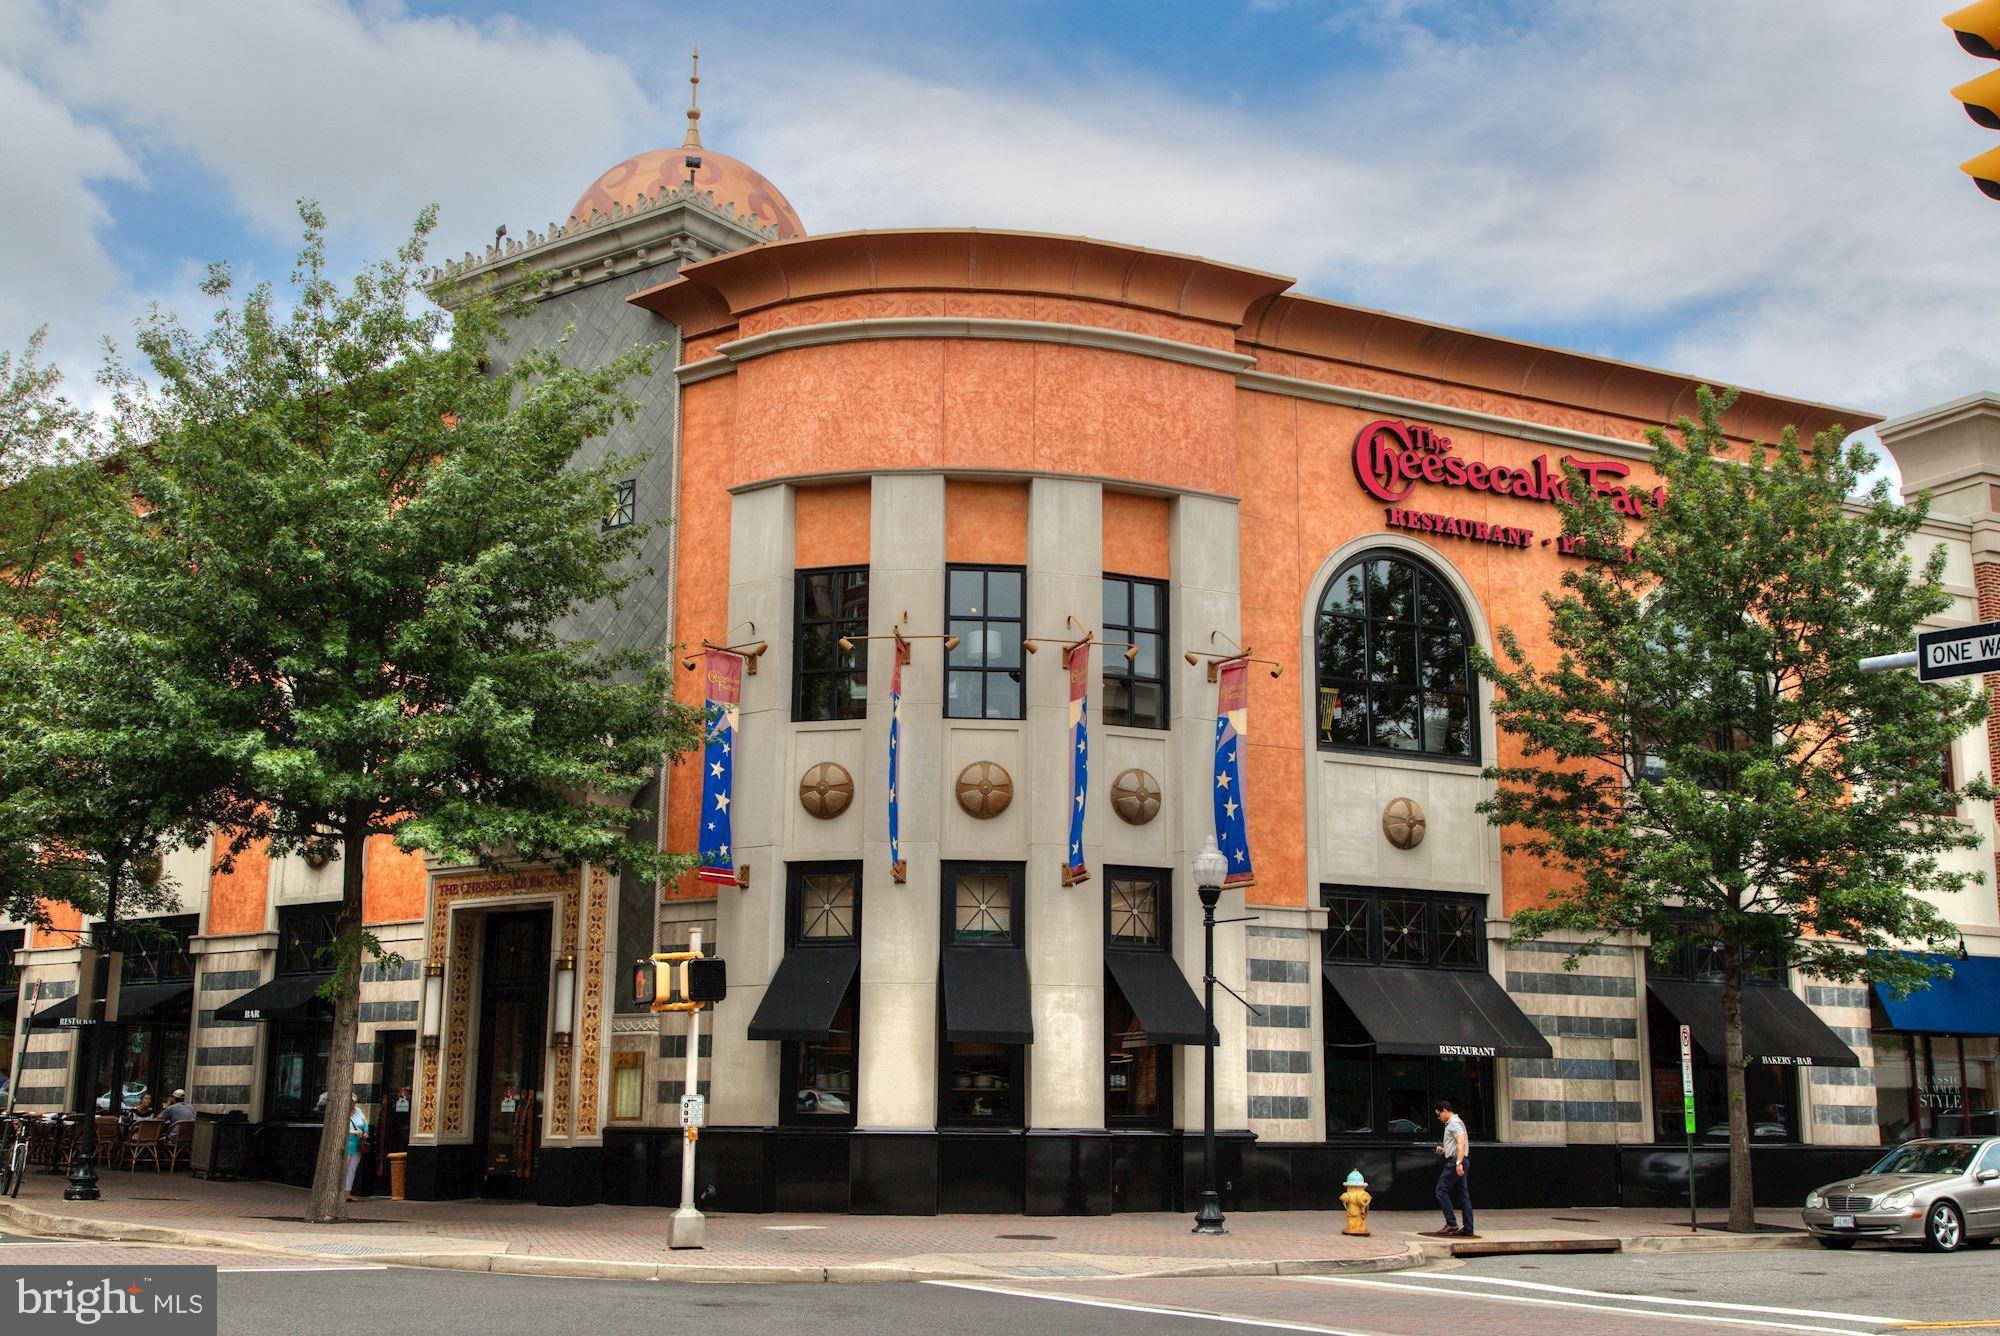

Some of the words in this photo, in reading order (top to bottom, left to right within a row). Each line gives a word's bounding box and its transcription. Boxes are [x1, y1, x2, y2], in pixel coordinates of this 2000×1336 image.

[1409, 425, 1453, 454] The
[1353, 420, 1579, 507] Cheesecake
[1562, 455, 1669, 519] Fact
[1387, 508, 1534, 548] RESTAURANT
[1933, 641, 1972, 664] ONE
[1980, 635, 2000, 657] WA
[244, 1009, 260, 1018] BAR
[1439, 1045, 1496, 1056] RESTAURANT
[1761, 1055, 1792, 1065] BAKERY
[1796, 1056, 1813, 1065] BAR
[1919, 1094, 1962, 1108] STYLE
